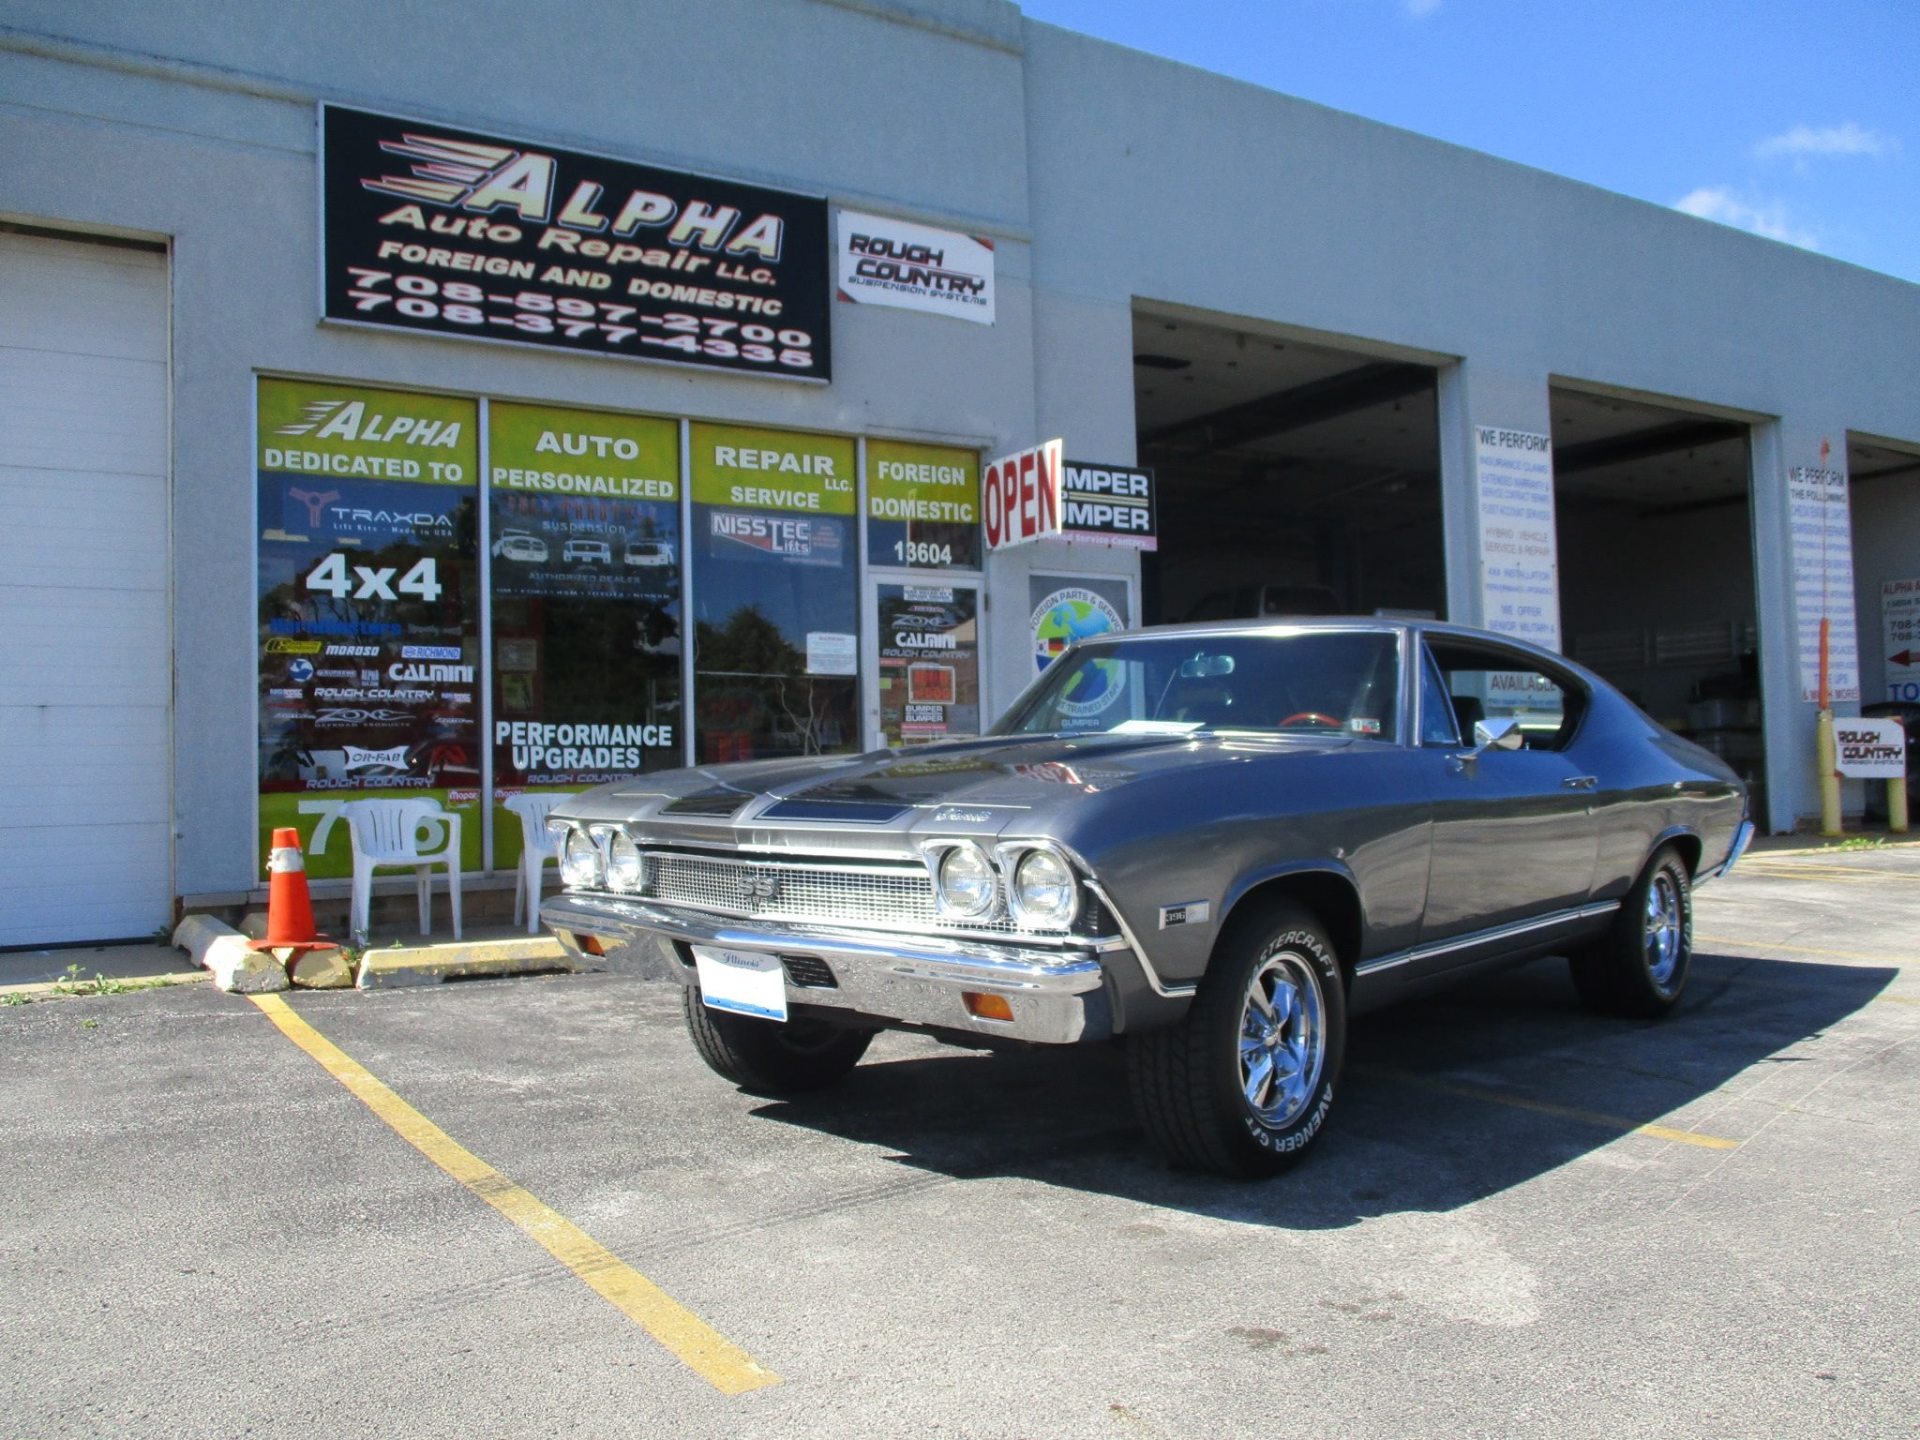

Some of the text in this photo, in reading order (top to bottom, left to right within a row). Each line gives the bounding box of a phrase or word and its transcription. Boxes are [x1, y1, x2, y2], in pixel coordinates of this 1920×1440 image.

[462, 150, 785, 263] ALPHA
[379, 205, 777, 286] Auto Repair LLC.
[849, 232, 944, 267] ROUGH
[378, 240, 783, 316] FOREIGN AND DOMESTIC
[856, 258, 985, 295] COUNTRY
[848, 276, 987, 306] SUSPENSION SYSTEMS
[347, 267, 812, 348] 708-597-2700
[347, 290, 813, 368] 708-377-4335
[316, 401, 461, 448] ALPHA
[535, 431, 640, 460] AUTO
[1480, 429, 1548, 453] WE PERFORM
[265, 448, 463, 481] DEDICATED TO
[715, 446, 853, 492] REPAIR LLC.
[878, 461, 965, 485] FOREIGN
[493, 468, 674, 497] PERSONALIZED
[730, 485, 820, 509] SERVICE
[871, 497, 972, 522] DOMESTIC
[984, 447, 1057, 548] OPEN
[331, 508, 453, 527] TRAXDA
[542, 521, 626, 535] suspension
[894, 540, 952, 564] 13604
[1060, 590, 1089, 601] PARTS
[1098, 602, 1122, 631] SERVIC
[416, 647, 461, 659] RICHMOND
[882, 649, 918, 657] ROUGH
[314, 688, 364, 698] ROUGH
[368, 689, 435, 700] COUNTRY
[1889, 682, 1920, 701] TO
[496, 721, 672, 746] PERFORMANCE
[1838, 731, 1880, 744] ROUGH
[352, 753, 401, 763] OR-FAB
[512, 746, 640, 770] UPGRADES
[1843, 747, 1902, 759] COUNTRY
[306, 775, 435, 789] ROUGH COUNTRY
[527, 774, 574, 784] ROUGH
[738, 874, 779, 899] SS
[1166, 910, 1185, 922] 396
[723, 952, 760, 968] Illinois
[1274, 1082, 1333, 1153] AVENGER
